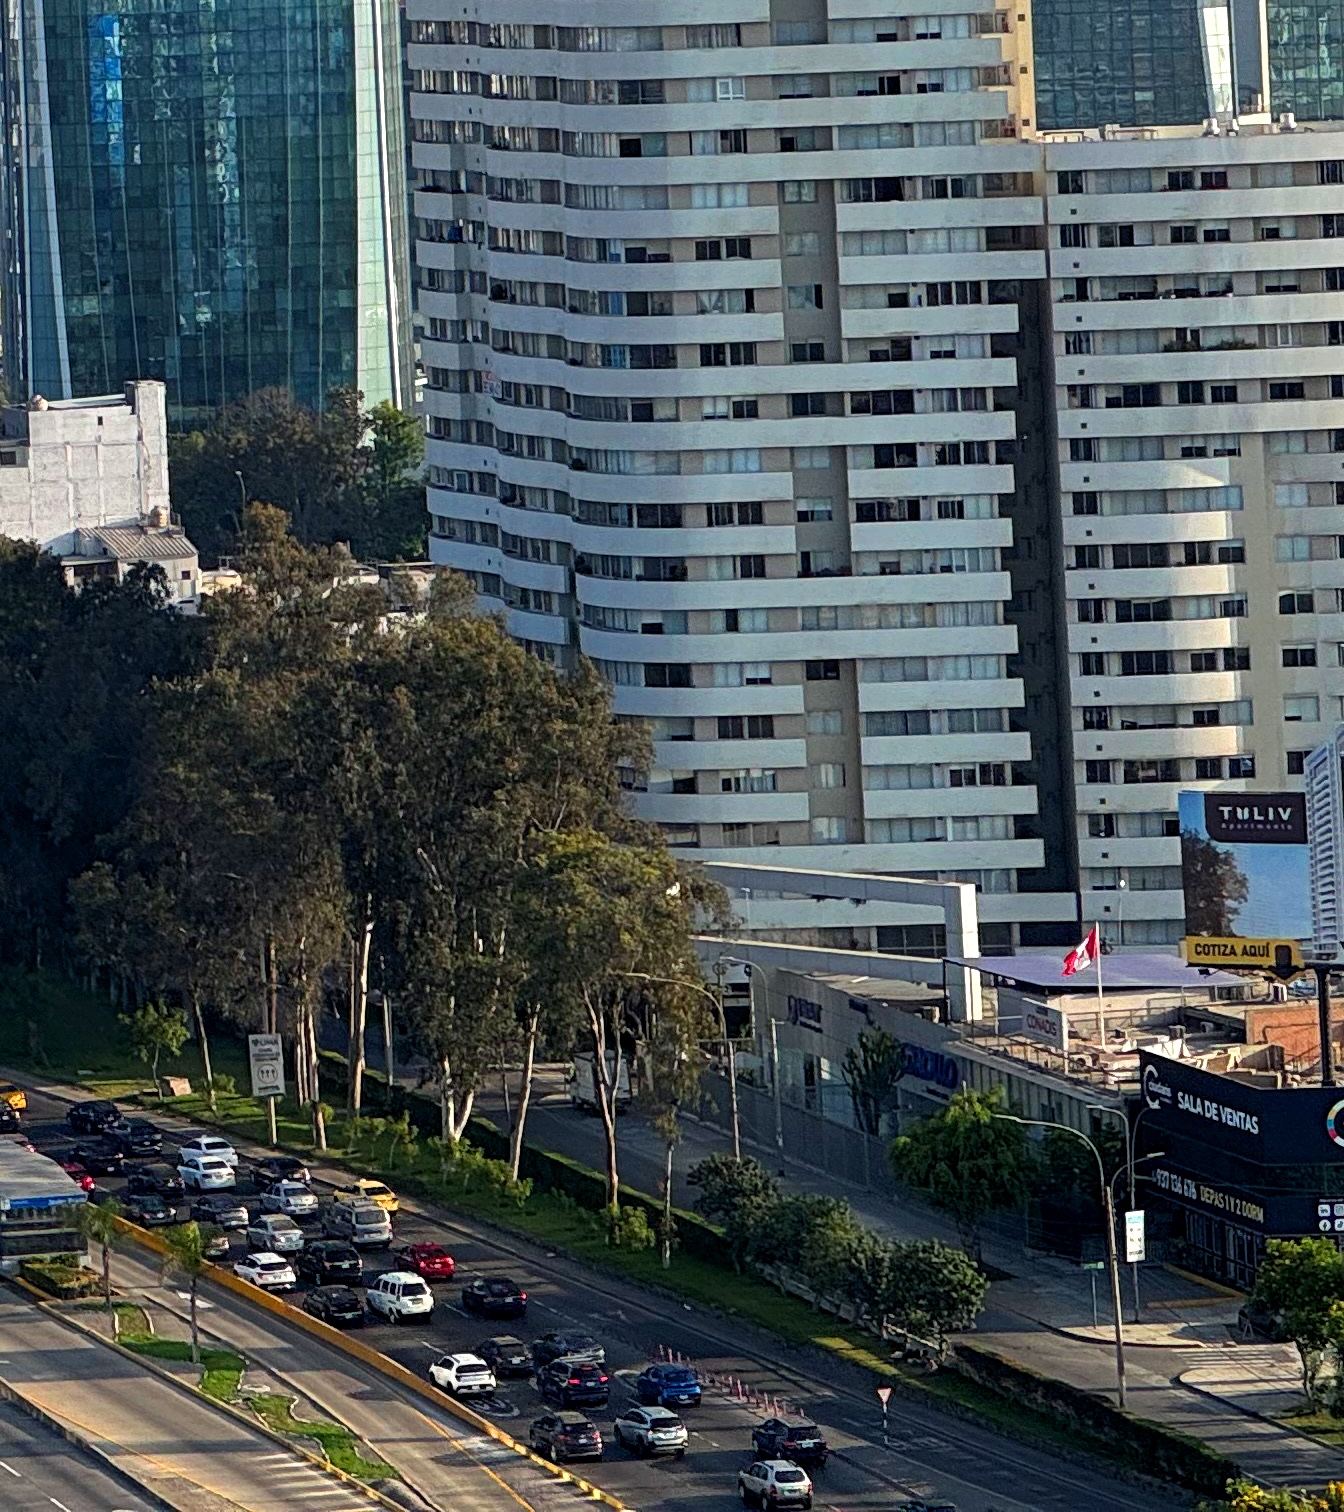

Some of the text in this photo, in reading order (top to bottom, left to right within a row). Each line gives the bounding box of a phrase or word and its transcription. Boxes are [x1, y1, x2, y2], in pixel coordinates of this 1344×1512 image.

[1194, 942, 1271, 958] COTIZA AQUÍ
[1177, 1091, 1260, 1135] SALA DE VENTAS
[1199, 1185, 1225, 1209] DEPAS
[1235, 1198, 1242, 1215] 2
